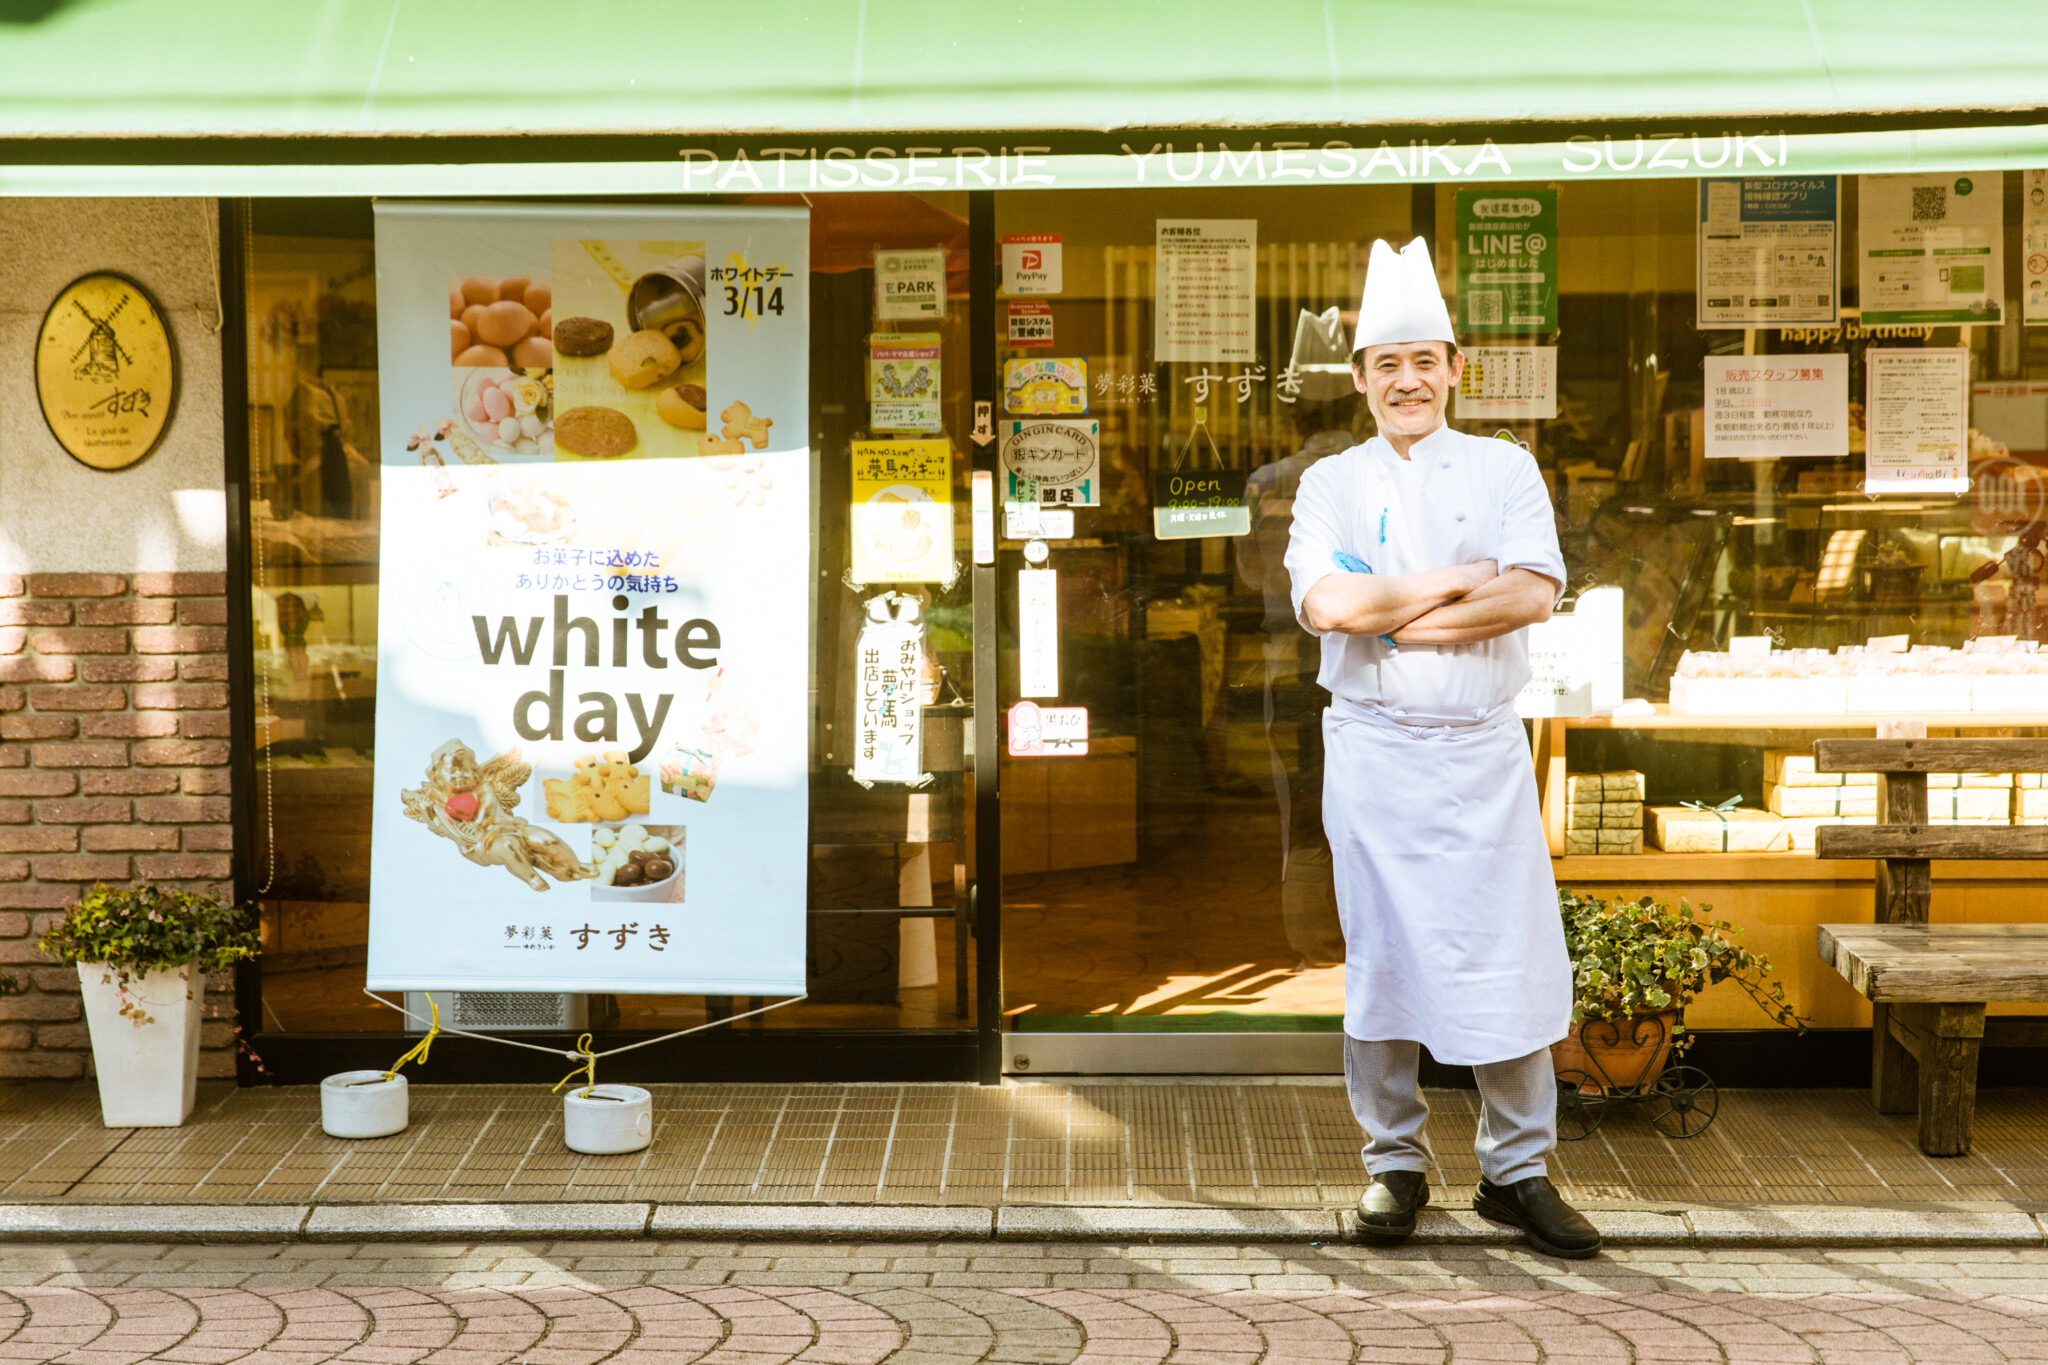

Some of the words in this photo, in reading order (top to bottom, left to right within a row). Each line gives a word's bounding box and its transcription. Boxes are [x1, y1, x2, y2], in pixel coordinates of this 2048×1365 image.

[678, 146, 1057, 190] PATISSERIE
[1120, 138, 1512, 183] YUMESAIKA
[1562, 129, 1788, 173] SUZUKI
[1475, 258, 1539, 269] はじめました
[710, 267, 794, 282] ホワイトデー
[1016, 272, 1048, 281] PayPay
[723, 286, 784, 318] 3/14
[1095, 373, 1157, 396] 夢彩菓
[1184, 366, 1303, 403] すずき
[1725, 368, 1824, 382] 販売スタッフ募集
[977, 405, 989, 435] 押す
[1012, 430, 1032, 446] GIN
[1055, 427, 1086, 445] CARD
[1170, 476, 1221, 496] Open
[533, 549, 660, 568] お菓子に込めた
[515, 573, 679, 593] ありがとうの気持ち
[471, 594, 722, 670] white
[863, 648, 879, 760] 出店しています
[513, 669, 675, 765] day
[504, 925, 553, 940] 夢彩菓
[570, 922, 671, 951] すずき
